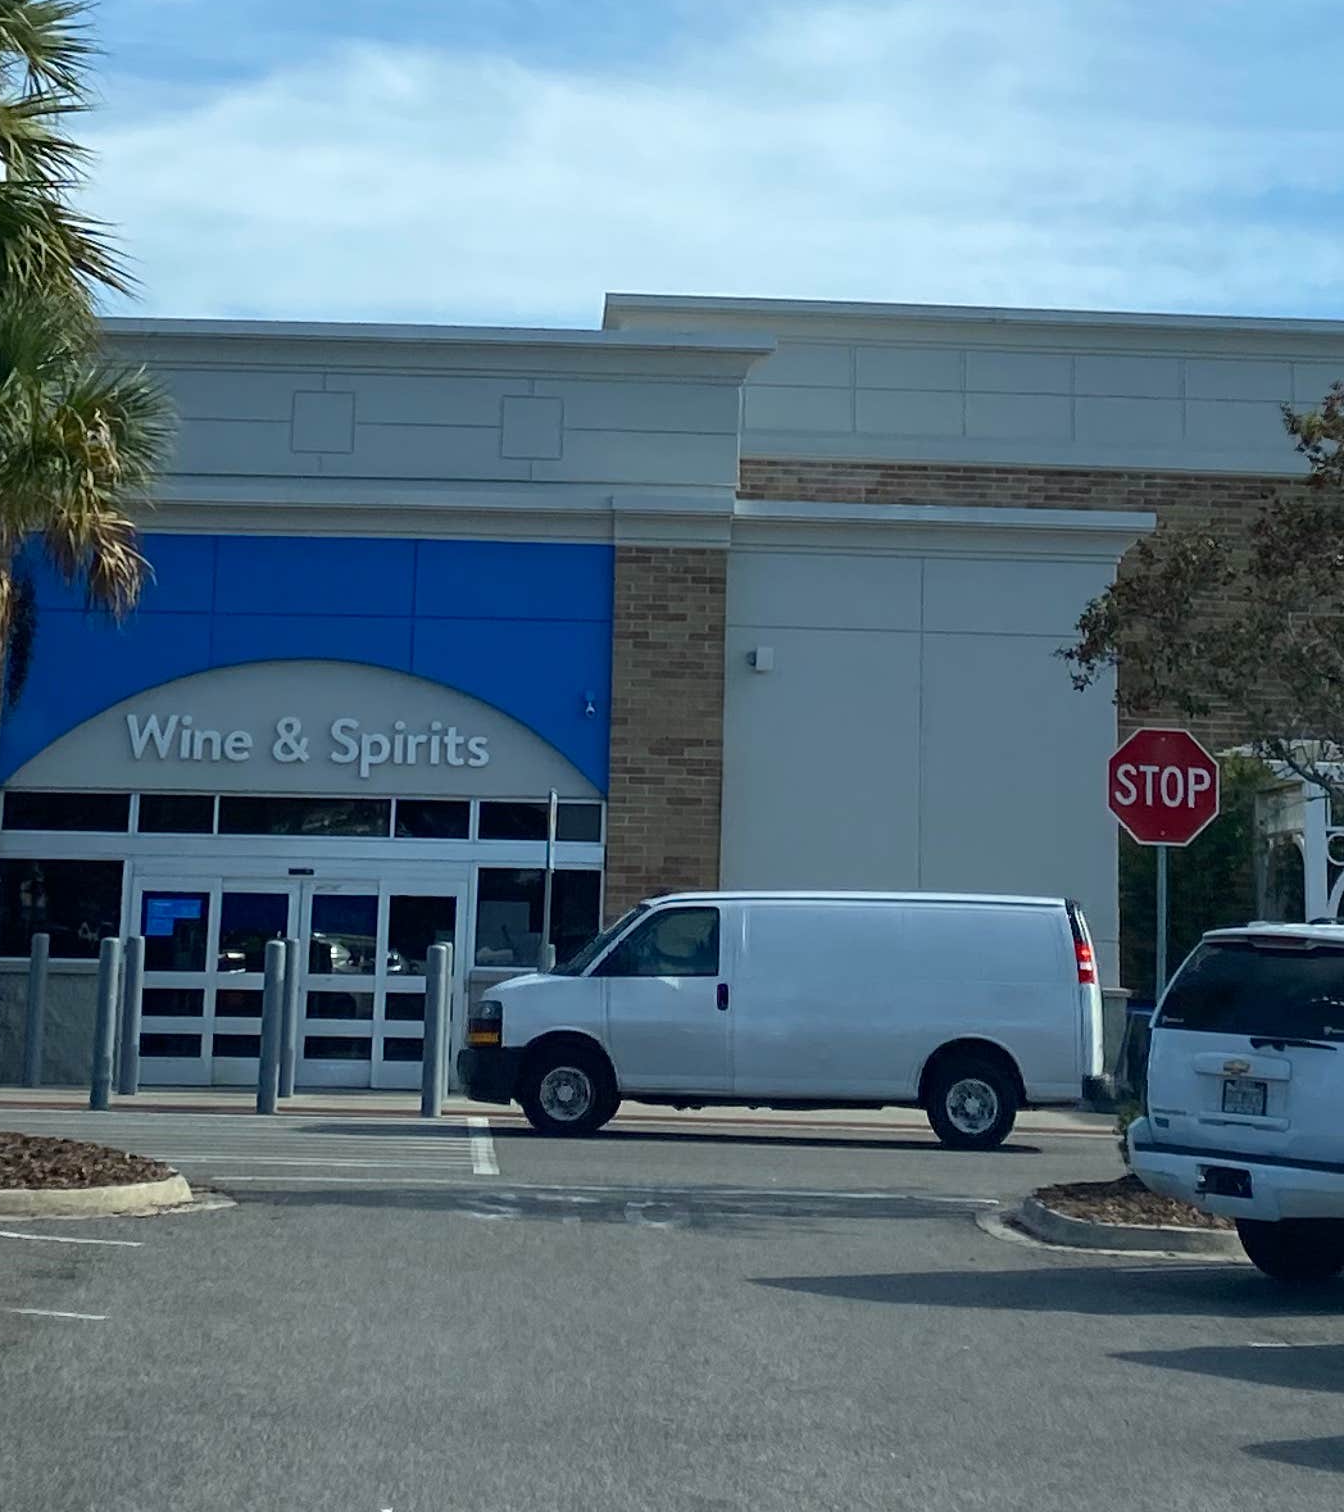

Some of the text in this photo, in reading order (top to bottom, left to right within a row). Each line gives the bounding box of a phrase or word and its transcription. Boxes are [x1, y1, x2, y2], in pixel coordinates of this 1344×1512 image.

[126, 714, 490, 778] Wine & Spirits
[1115, 763, 1212, 808] STOP
